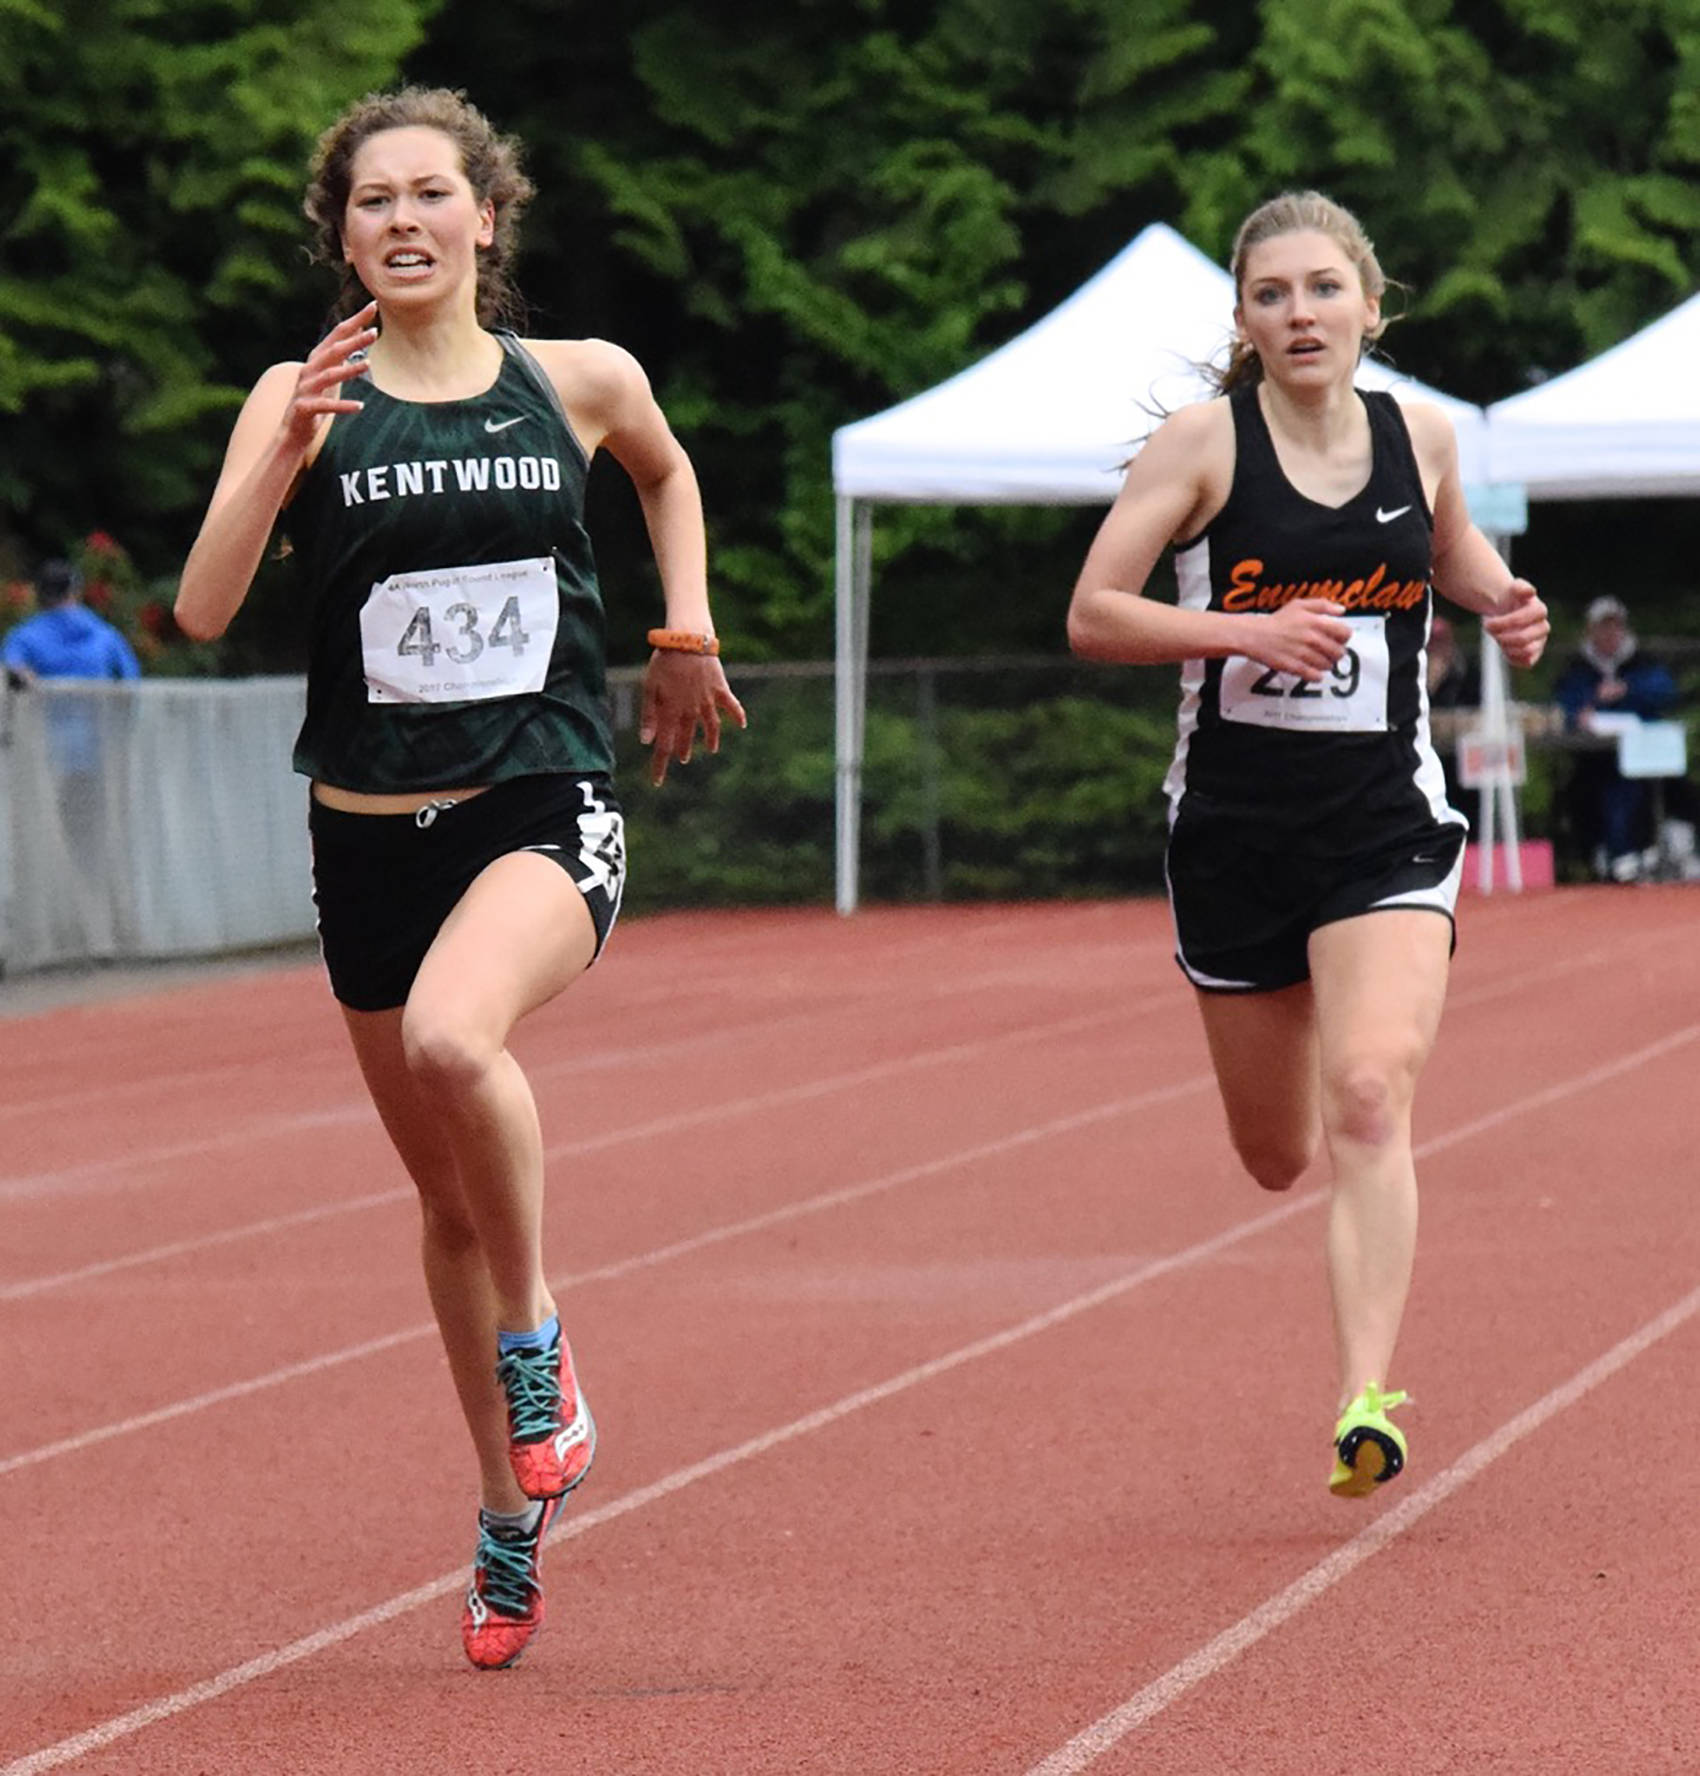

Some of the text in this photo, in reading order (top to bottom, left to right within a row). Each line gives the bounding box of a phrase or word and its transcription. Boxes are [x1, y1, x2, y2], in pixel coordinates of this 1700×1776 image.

[339, 457, 561, 507] KENTWOOD
[1222, 558, 1427, 611] Enumclaw
[397, 596, 530, 667] 434
